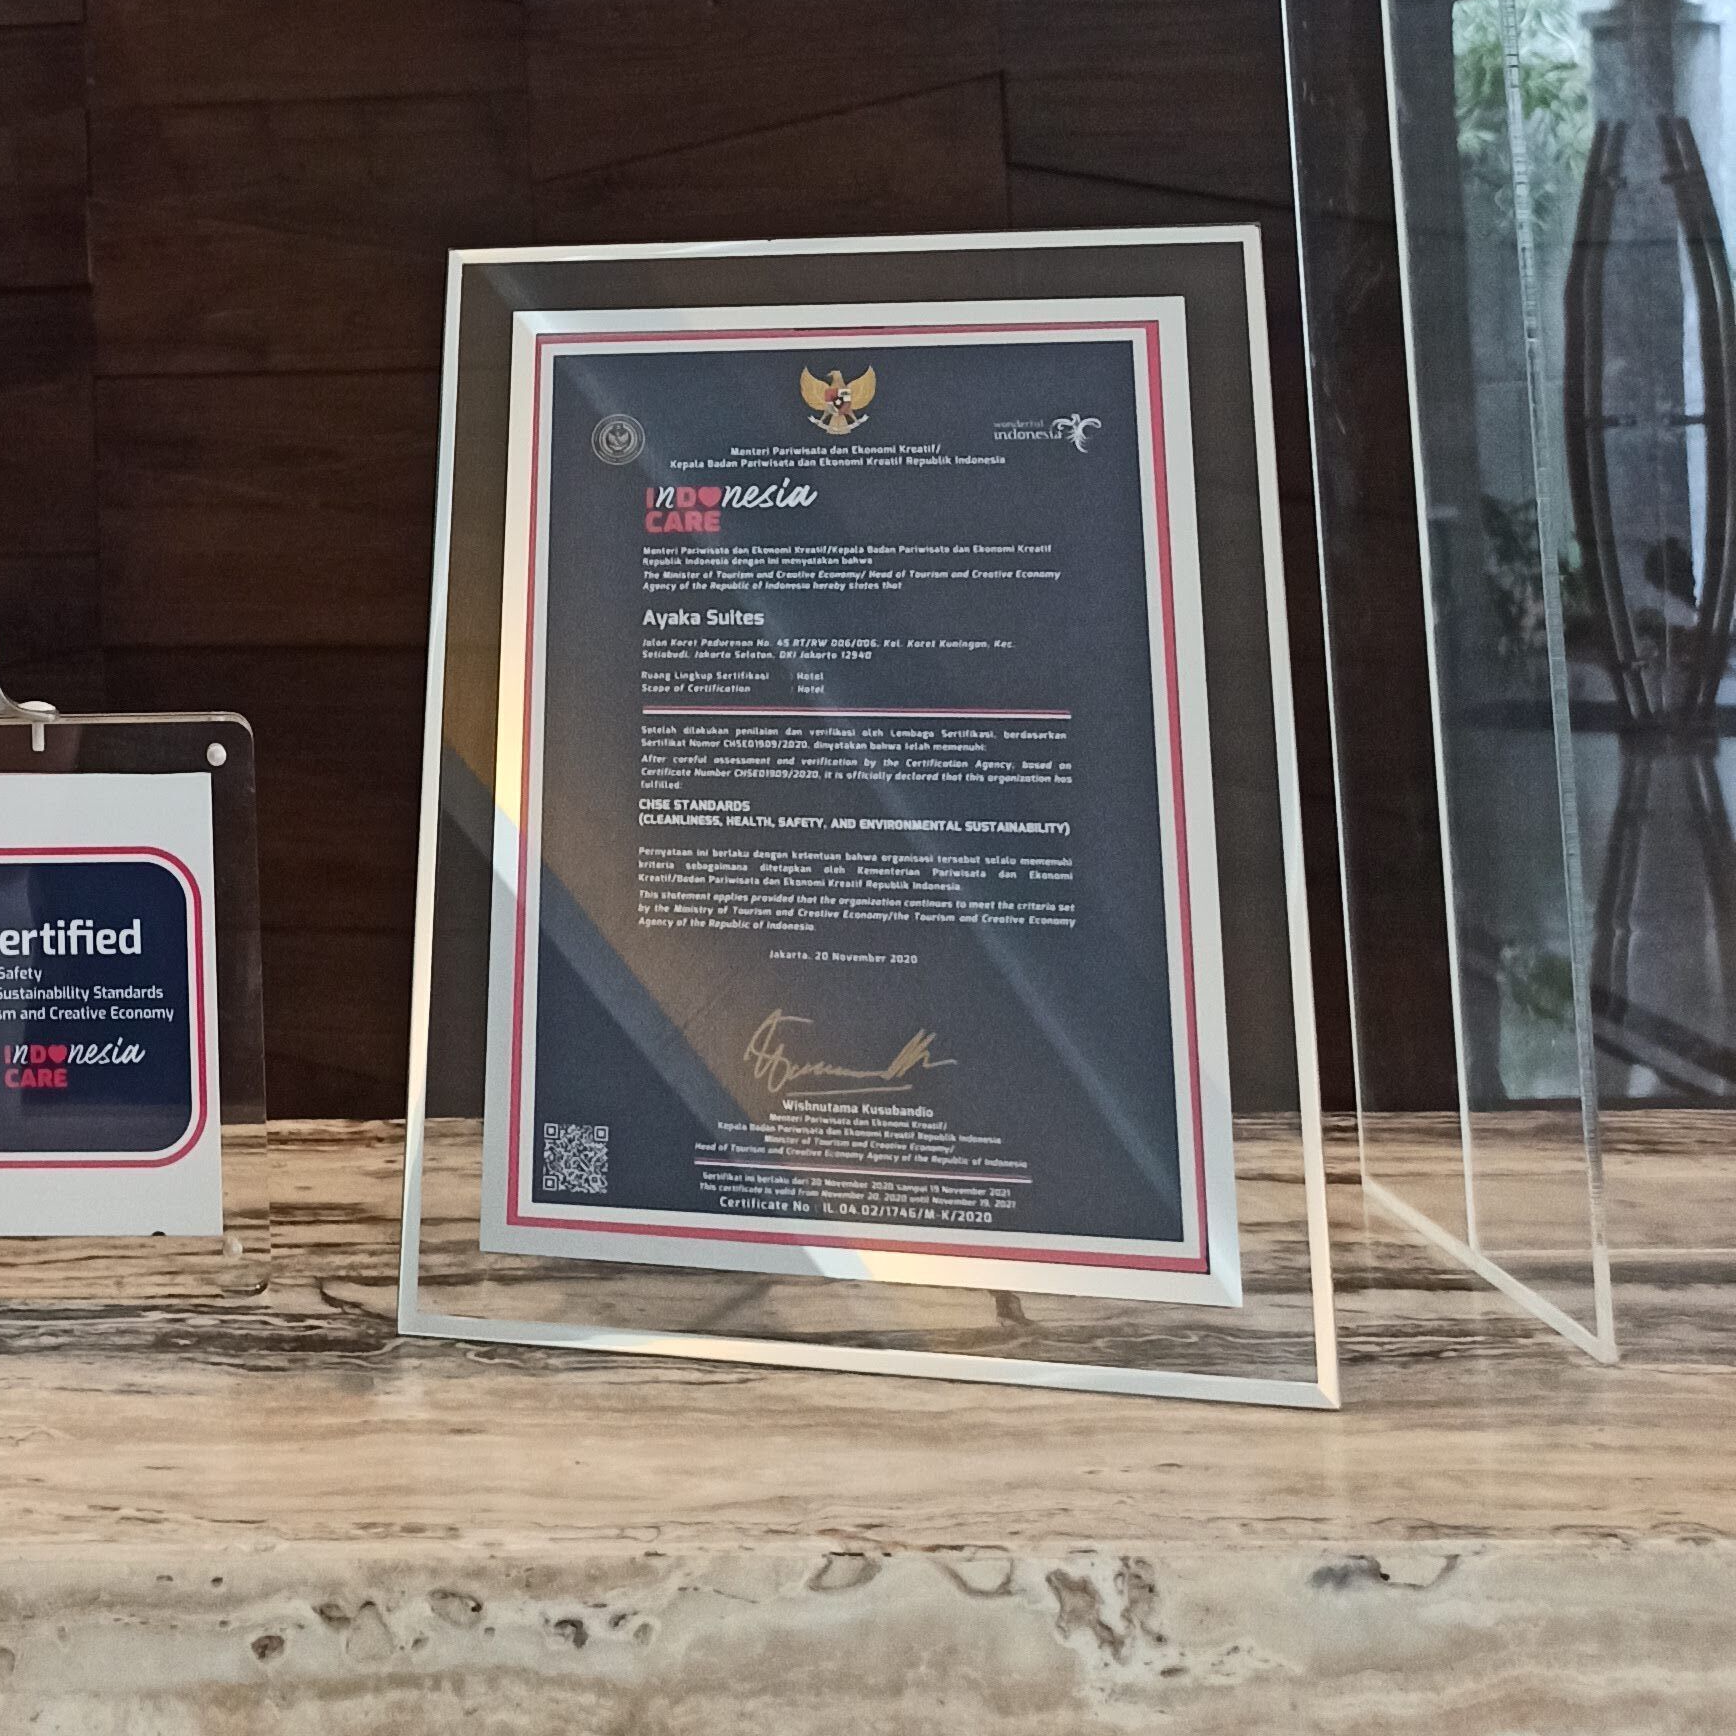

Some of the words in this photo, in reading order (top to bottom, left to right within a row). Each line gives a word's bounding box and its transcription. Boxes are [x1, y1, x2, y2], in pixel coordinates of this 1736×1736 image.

[645, 509, 721, 532] CARE
[642, 608, 700, 629] Ayaka
[706, 609, 764, 625] Suites
[93, 985, 163, 998] Standards
[19, 1006, 45, 1019] and
[49, 1005, 106, 1019] Creative
[110, 1005, 173, 1020] Economy
[4, 1067, 67, 1087] CARE
